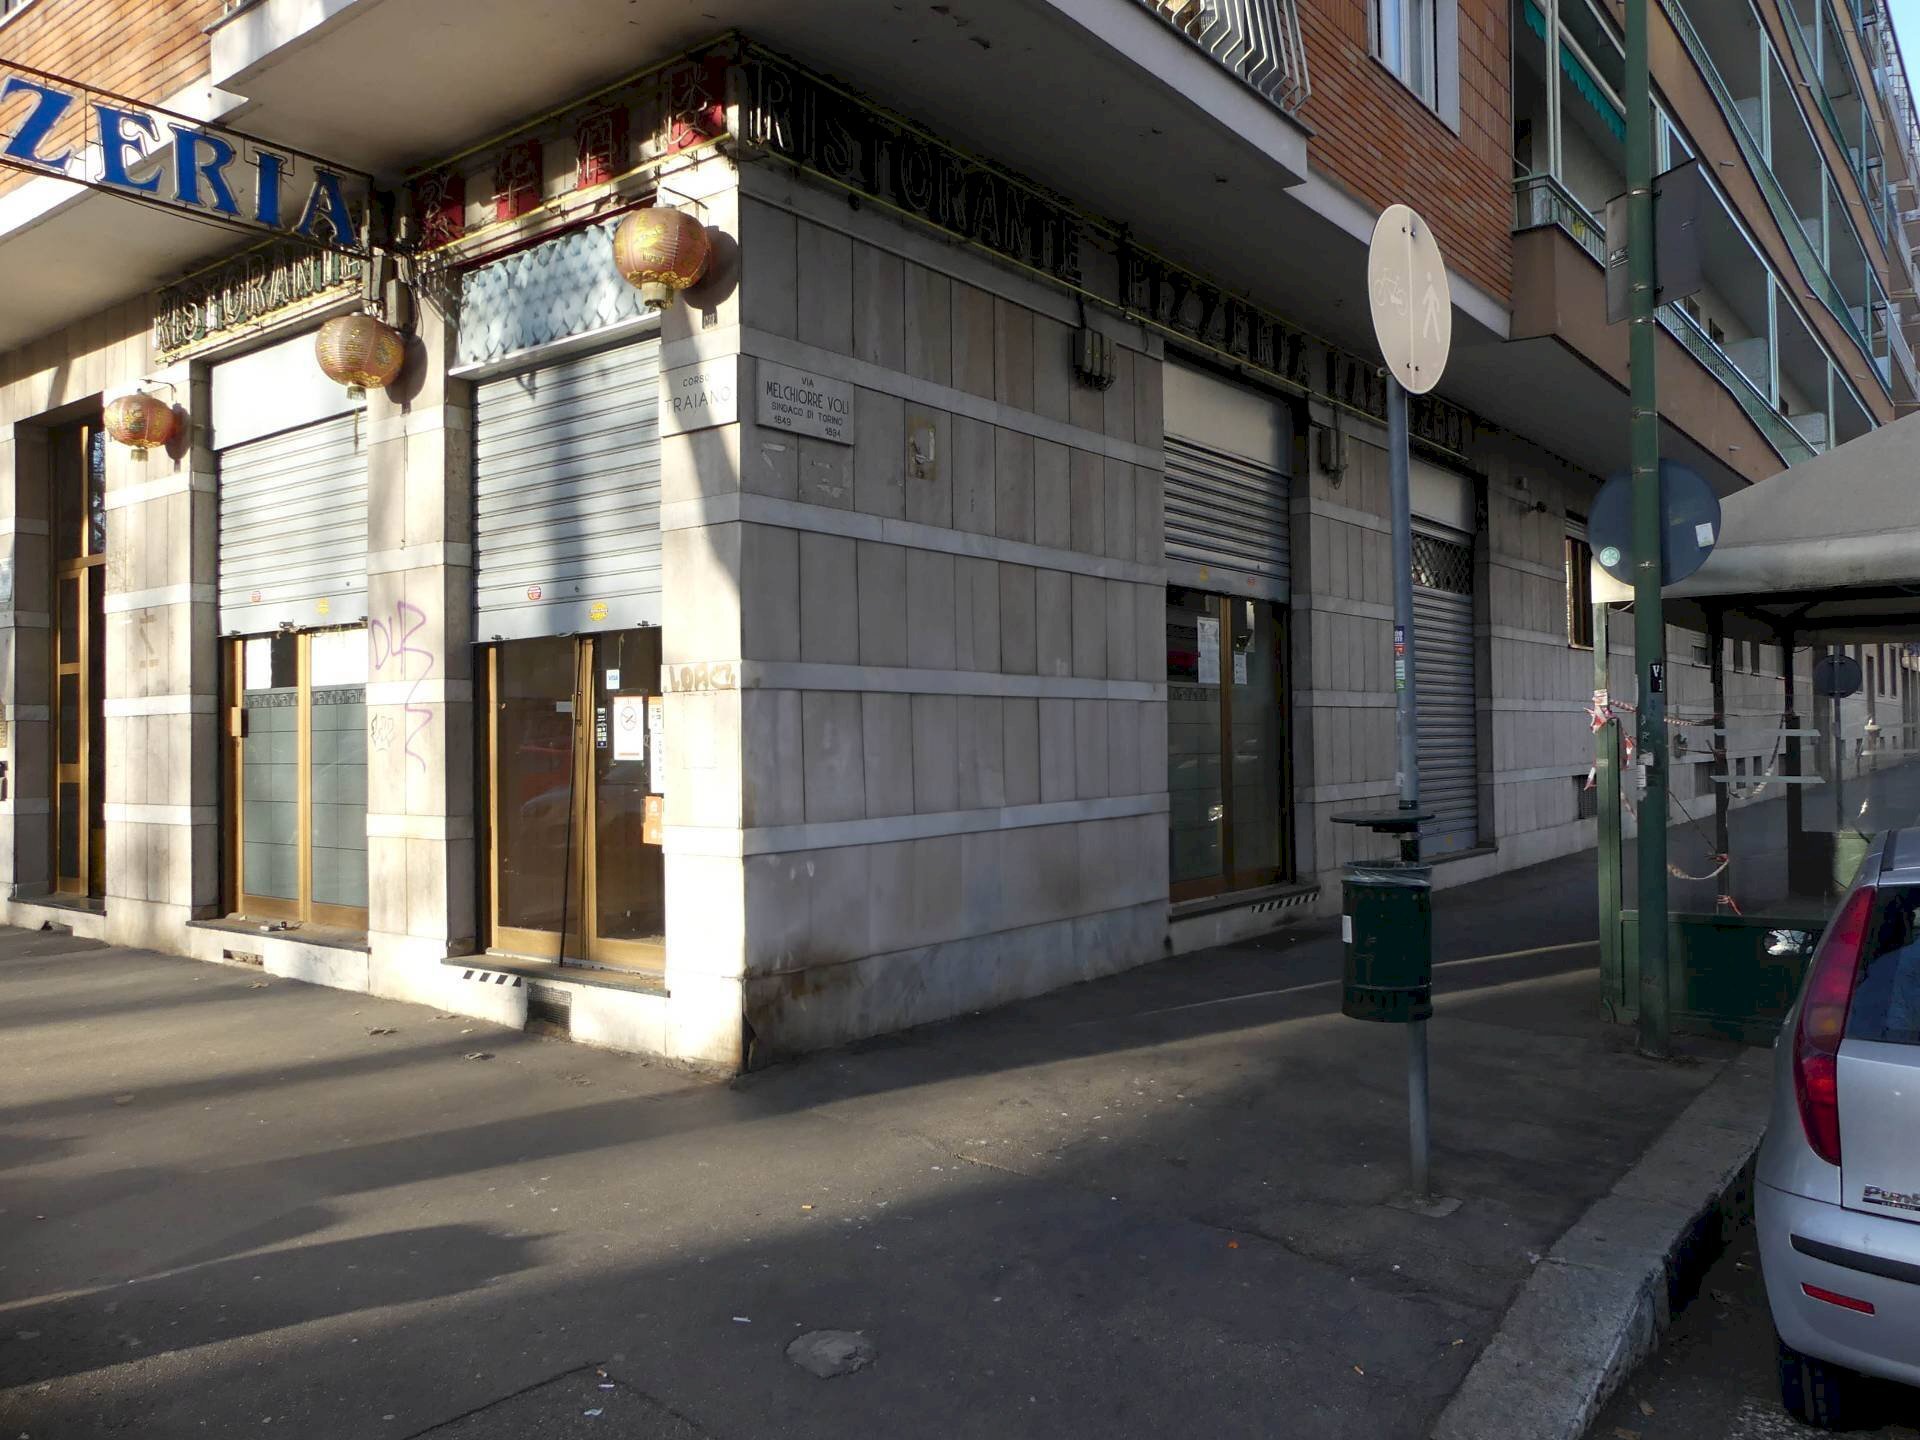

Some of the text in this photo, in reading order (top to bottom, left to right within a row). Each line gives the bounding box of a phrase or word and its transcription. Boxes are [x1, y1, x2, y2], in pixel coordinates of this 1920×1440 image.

[746, 61, 1081, 281] RISTORANTE
[682, 373, 710, 387] CORSO
[801, 377, 815, 388] VIA
[664, 386, 731, 414] TRAIANO
[766, 381, 849, 415] MELCHIORRE VOLI
[771, 401, 843, 426] SINDACO DI TORINO
